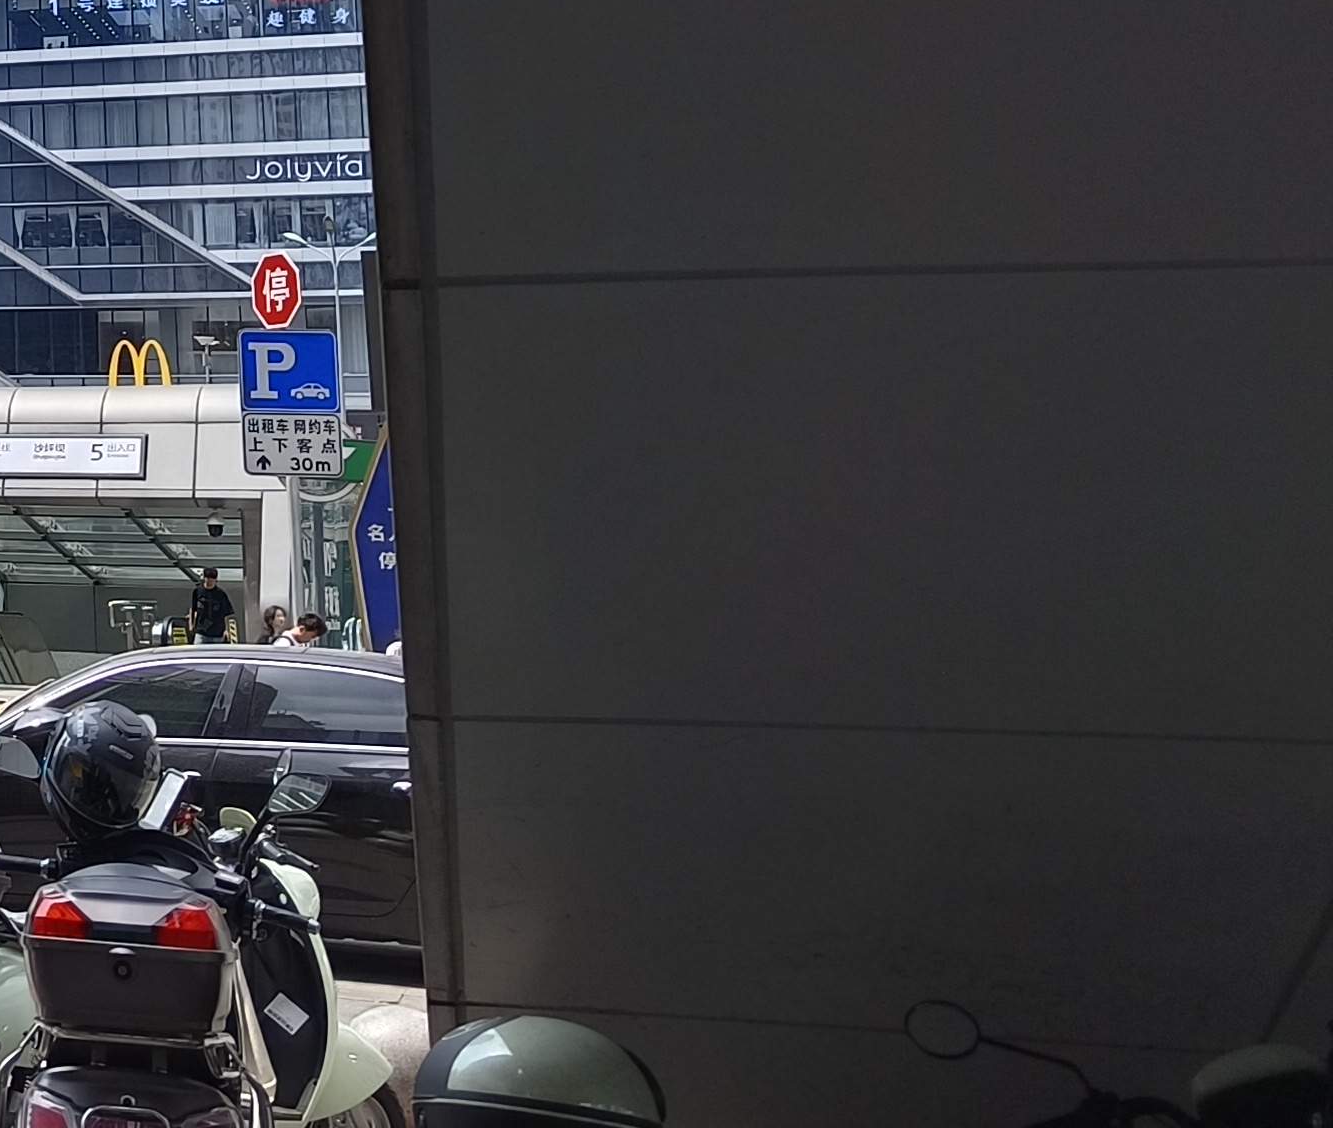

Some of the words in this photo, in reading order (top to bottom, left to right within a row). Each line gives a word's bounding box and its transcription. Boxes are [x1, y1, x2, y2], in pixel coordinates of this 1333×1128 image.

[263, 267, 290, 313] 停
[248, 342, 296, 399] P
[247, 418, 290, 434] 出租车
[294, 419, 337, 434] 网约车
[90, 443, 103, 461] 5
[290, 457, 331, 472] 30m
